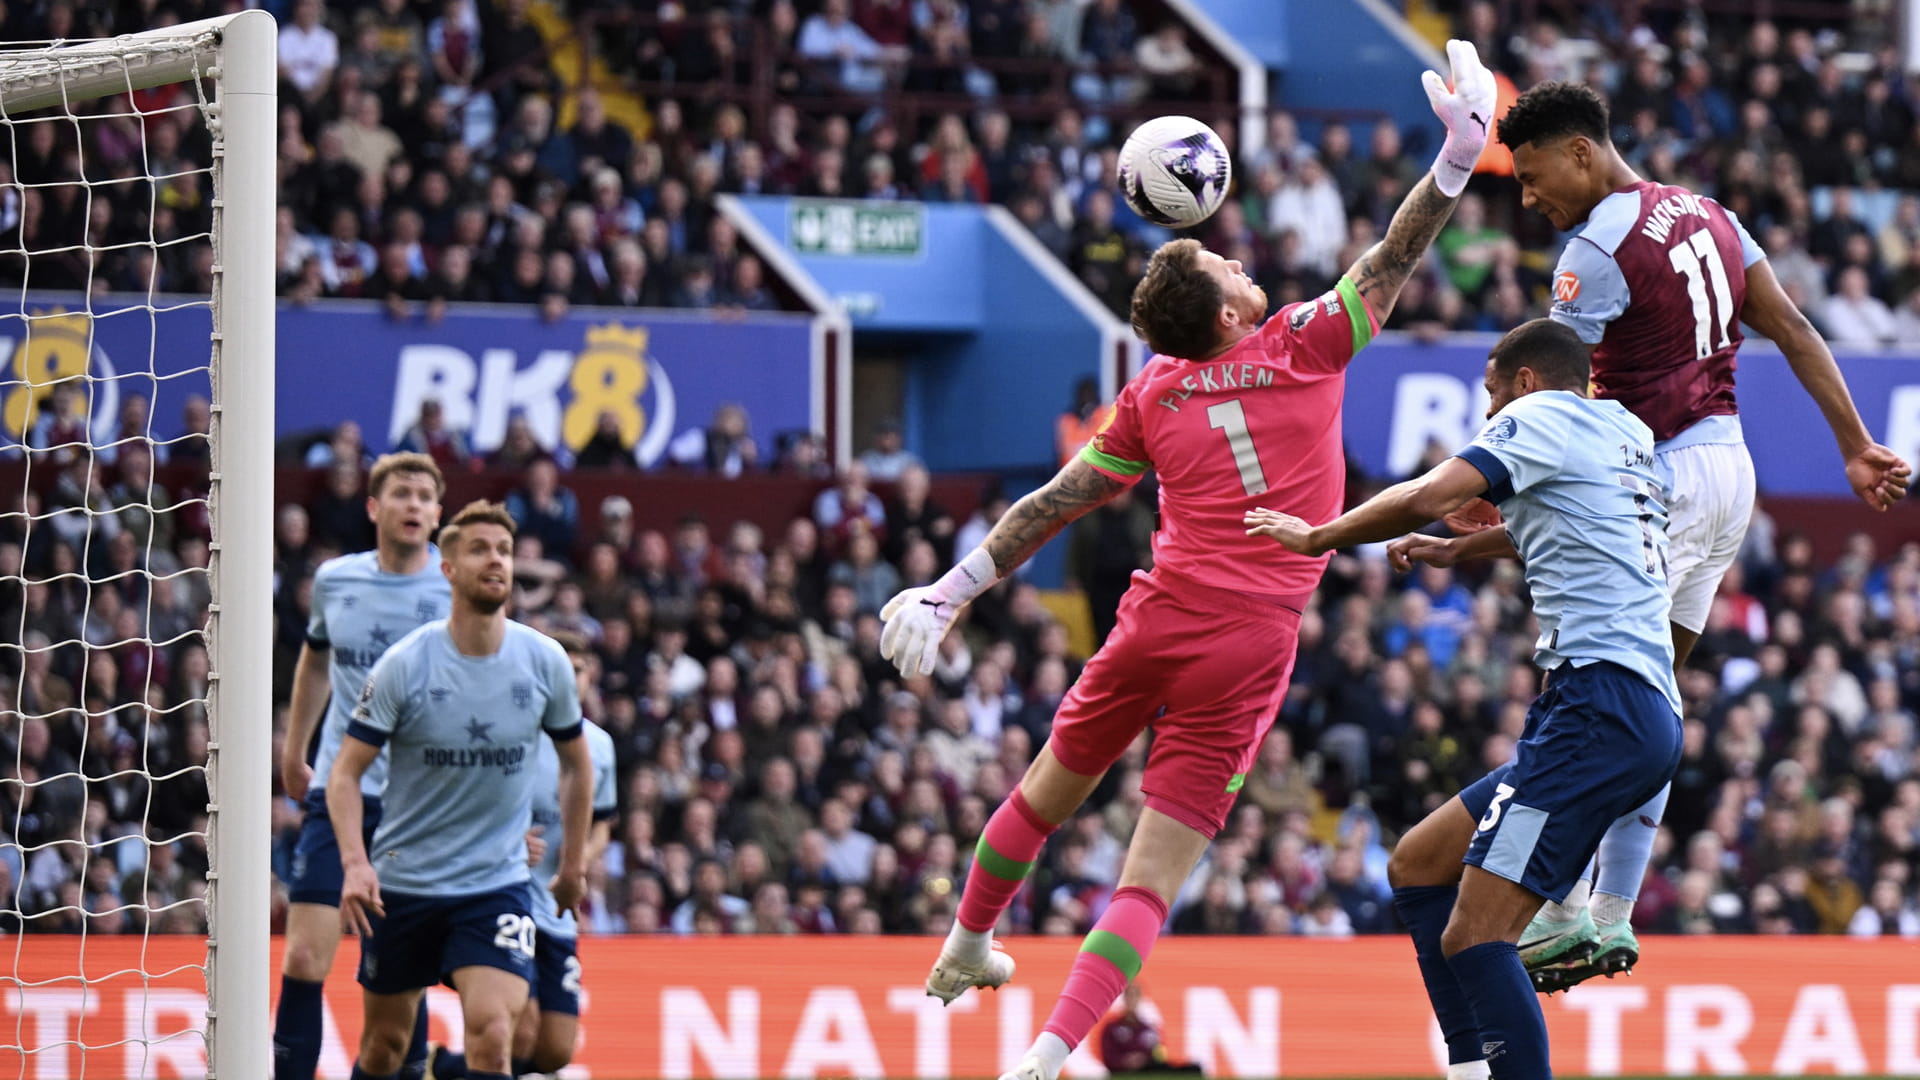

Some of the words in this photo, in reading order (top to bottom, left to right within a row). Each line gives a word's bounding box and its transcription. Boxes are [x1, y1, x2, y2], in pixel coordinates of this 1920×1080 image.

[856, 213, 918, 247] EXIT
[1668, 228, 1734, 361] 11
[388, 335, 648, 454] BK8
[1157, 362, 1275, 412] FLEKKEN
[1206, 398, 1269, 497] 1
[494, 912, 537, 960] 20
[659, 986, 1283, 1080] NATIN
